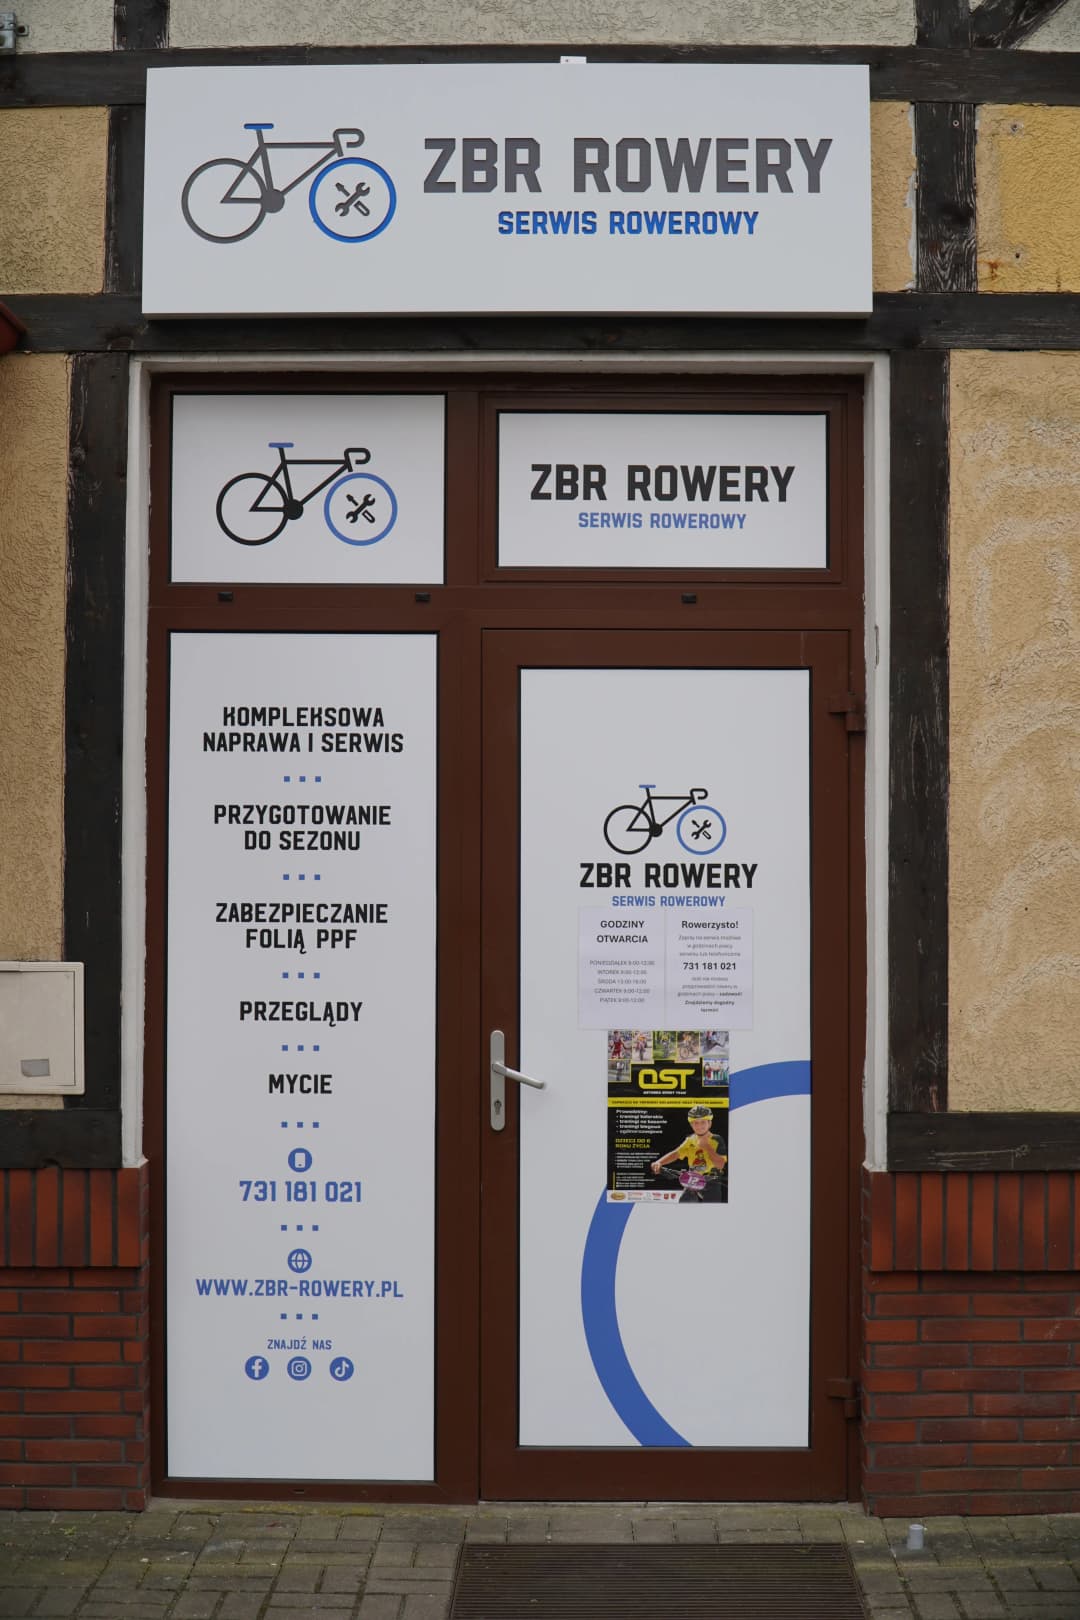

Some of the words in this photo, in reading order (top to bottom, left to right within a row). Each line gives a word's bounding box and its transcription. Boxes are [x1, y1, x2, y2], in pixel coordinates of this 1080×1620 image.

[424, 138, 542, 193] ZBR
[574, 138, 833, 193] ROWERY
[499, 211, 597, 234] SERWIS
[610, 211, 759, 234] ROWEROWY
[531, 464, 607, 500] ZBR
[628, 465, 795, 502] ROWERY
[579, 512, 642, 528] SERWIS
[650, 513, 746, 529] ROWEROWY
[224, 707, 384, 727] KOMPLEKSOWA
[204, 732, 300, 752] NAPRAWA
[309, 733, 313, 752] I
[321, 733, 403, 752] SERWIS
[214, 805, 391, 825] PRZYGOTOWANIE
[245, 831, 270, 850] DO
[279, 831, 360, 850] SEZONU
[580, 863, 631, 888] ZBR
[645, 863, 758, 888] ROWERY
[612, 896, 655, 906] SERWIS
[660, 896, 725, 906] ROWEROWY
[216, 903, 388, 923] ZABEZPIECZANIE
[600, 920, 645, 929] GODZINY
[682, 920, 738, 930] Rowerzysto!
[246, 929, 306, 954] FOLIĄ
[317, 929, 357, 948] PPF
[596, 935, 648, 944] OTWARCIA
[683, 962, 699, 970] 731
[702, 962, 718, 970] 181
[720, 962, 736, 970] 021
[240, 1001, 362, 1027] PRZEGLĄDY
[269, 1074, 332, 1094] MYCIE
[240, 1181, 276, 1201] 731
[285, 1181, 316, 1202] 181
[326, 1182, 361, 1202] 021
[196, 1279, 403, 1297] WWW.ZBR-ROWERY.PL
[268, 1336, 306, 1350] ZNAJDŹ
[313, 1340, 331, 1350] NAS
